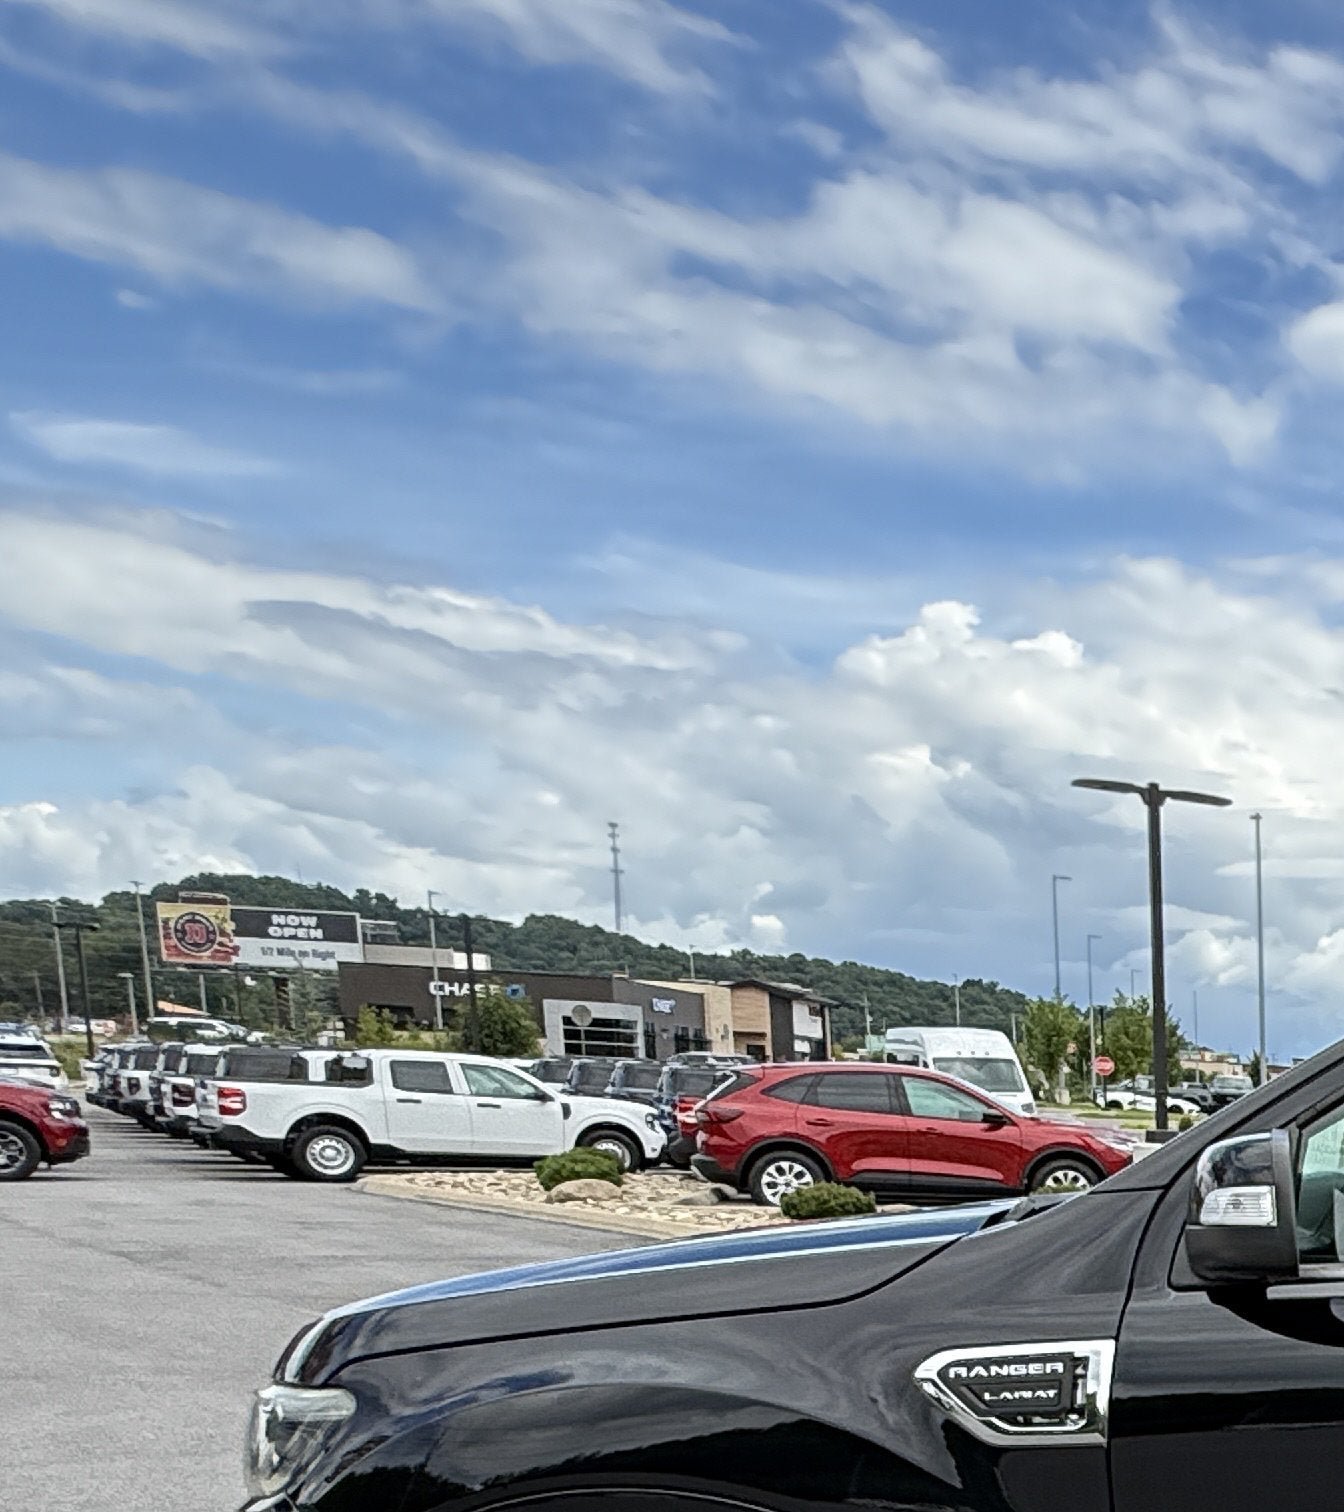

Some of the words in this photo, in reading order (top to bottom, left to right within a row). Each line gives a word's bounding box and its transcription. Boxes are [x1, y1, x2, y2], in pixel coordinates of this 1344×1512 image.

[271, 914, 318, 927] NOW
[268, 926, 323, 939] OPEN
[949, 1362, 1064, 1378] RANGER
[983, 1389, 1059, 1401] LARIAT
